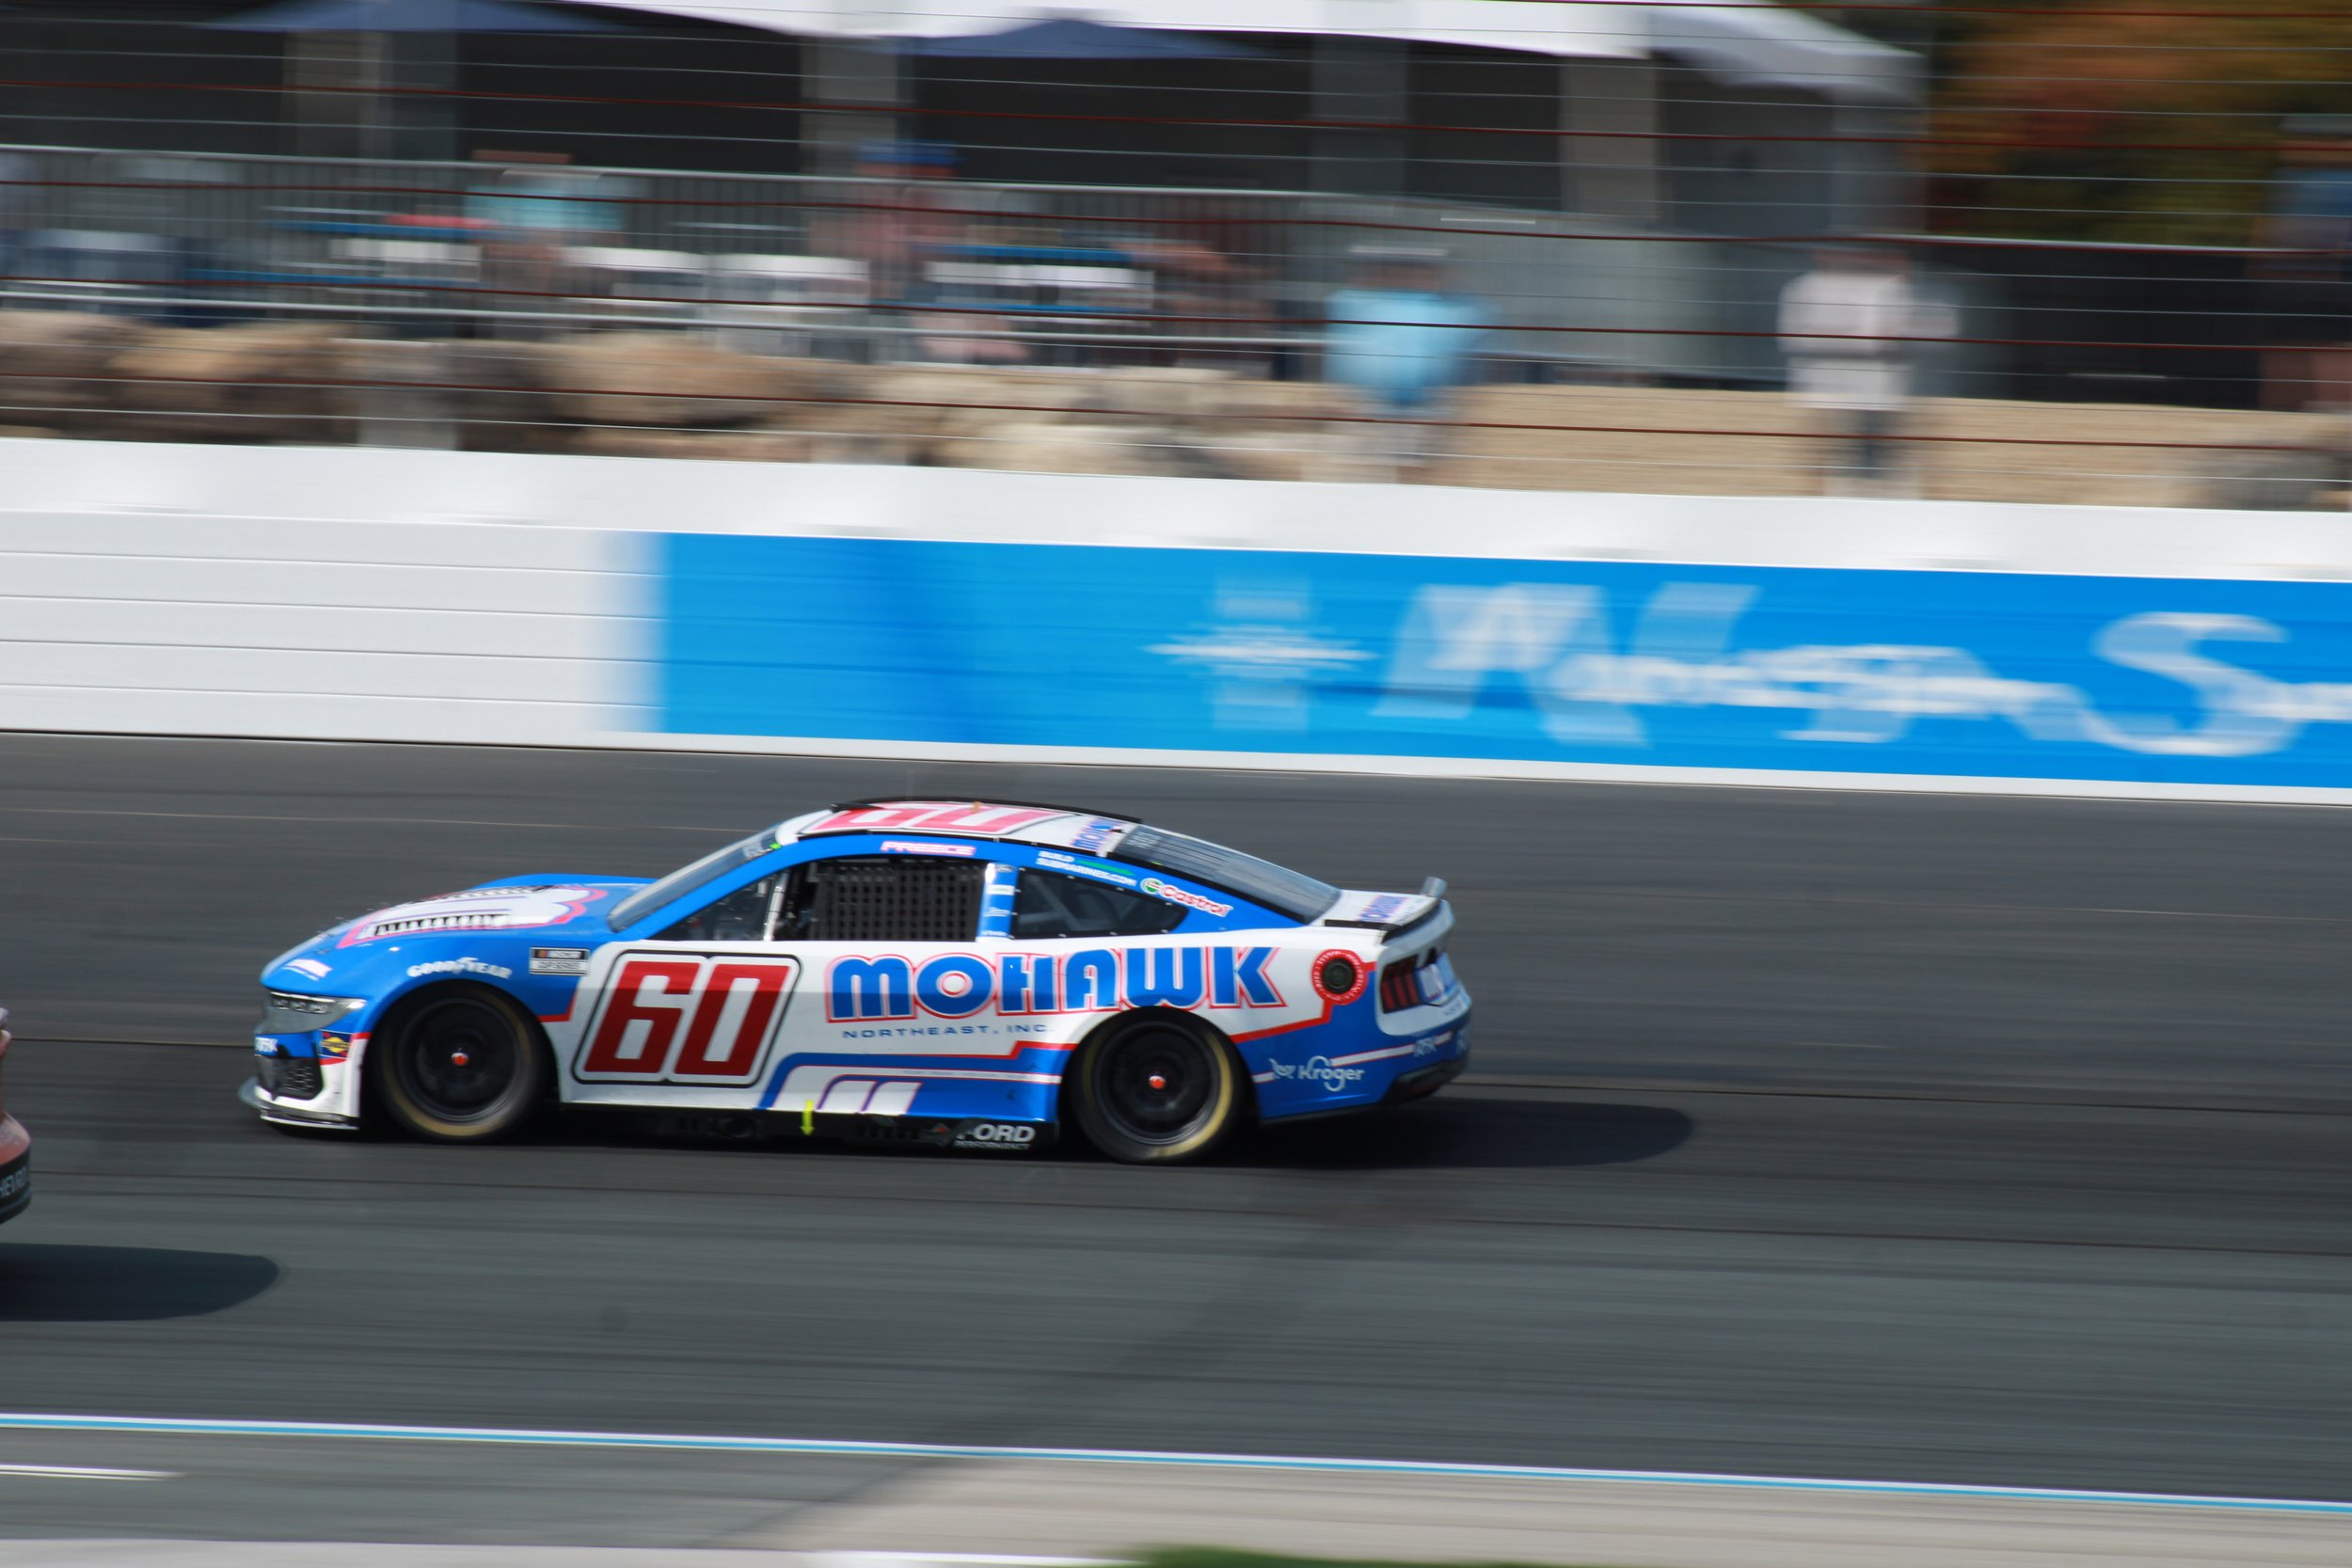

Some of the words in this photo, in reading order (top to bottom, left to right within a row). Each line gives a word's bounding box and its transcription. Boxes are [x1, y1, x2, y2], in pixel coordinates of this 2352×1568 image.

[1161, 884, 1233, 917] Castrol
[826, 945, 1288, 1023] MOHAWK
[583, 960, 791, 1077] 60
[841, 1025, 999, 1038] NORTHEAST,
[1297, 1054, 1365, 1092] Kroger
[956, 1123, 1036, 1143] ORD
